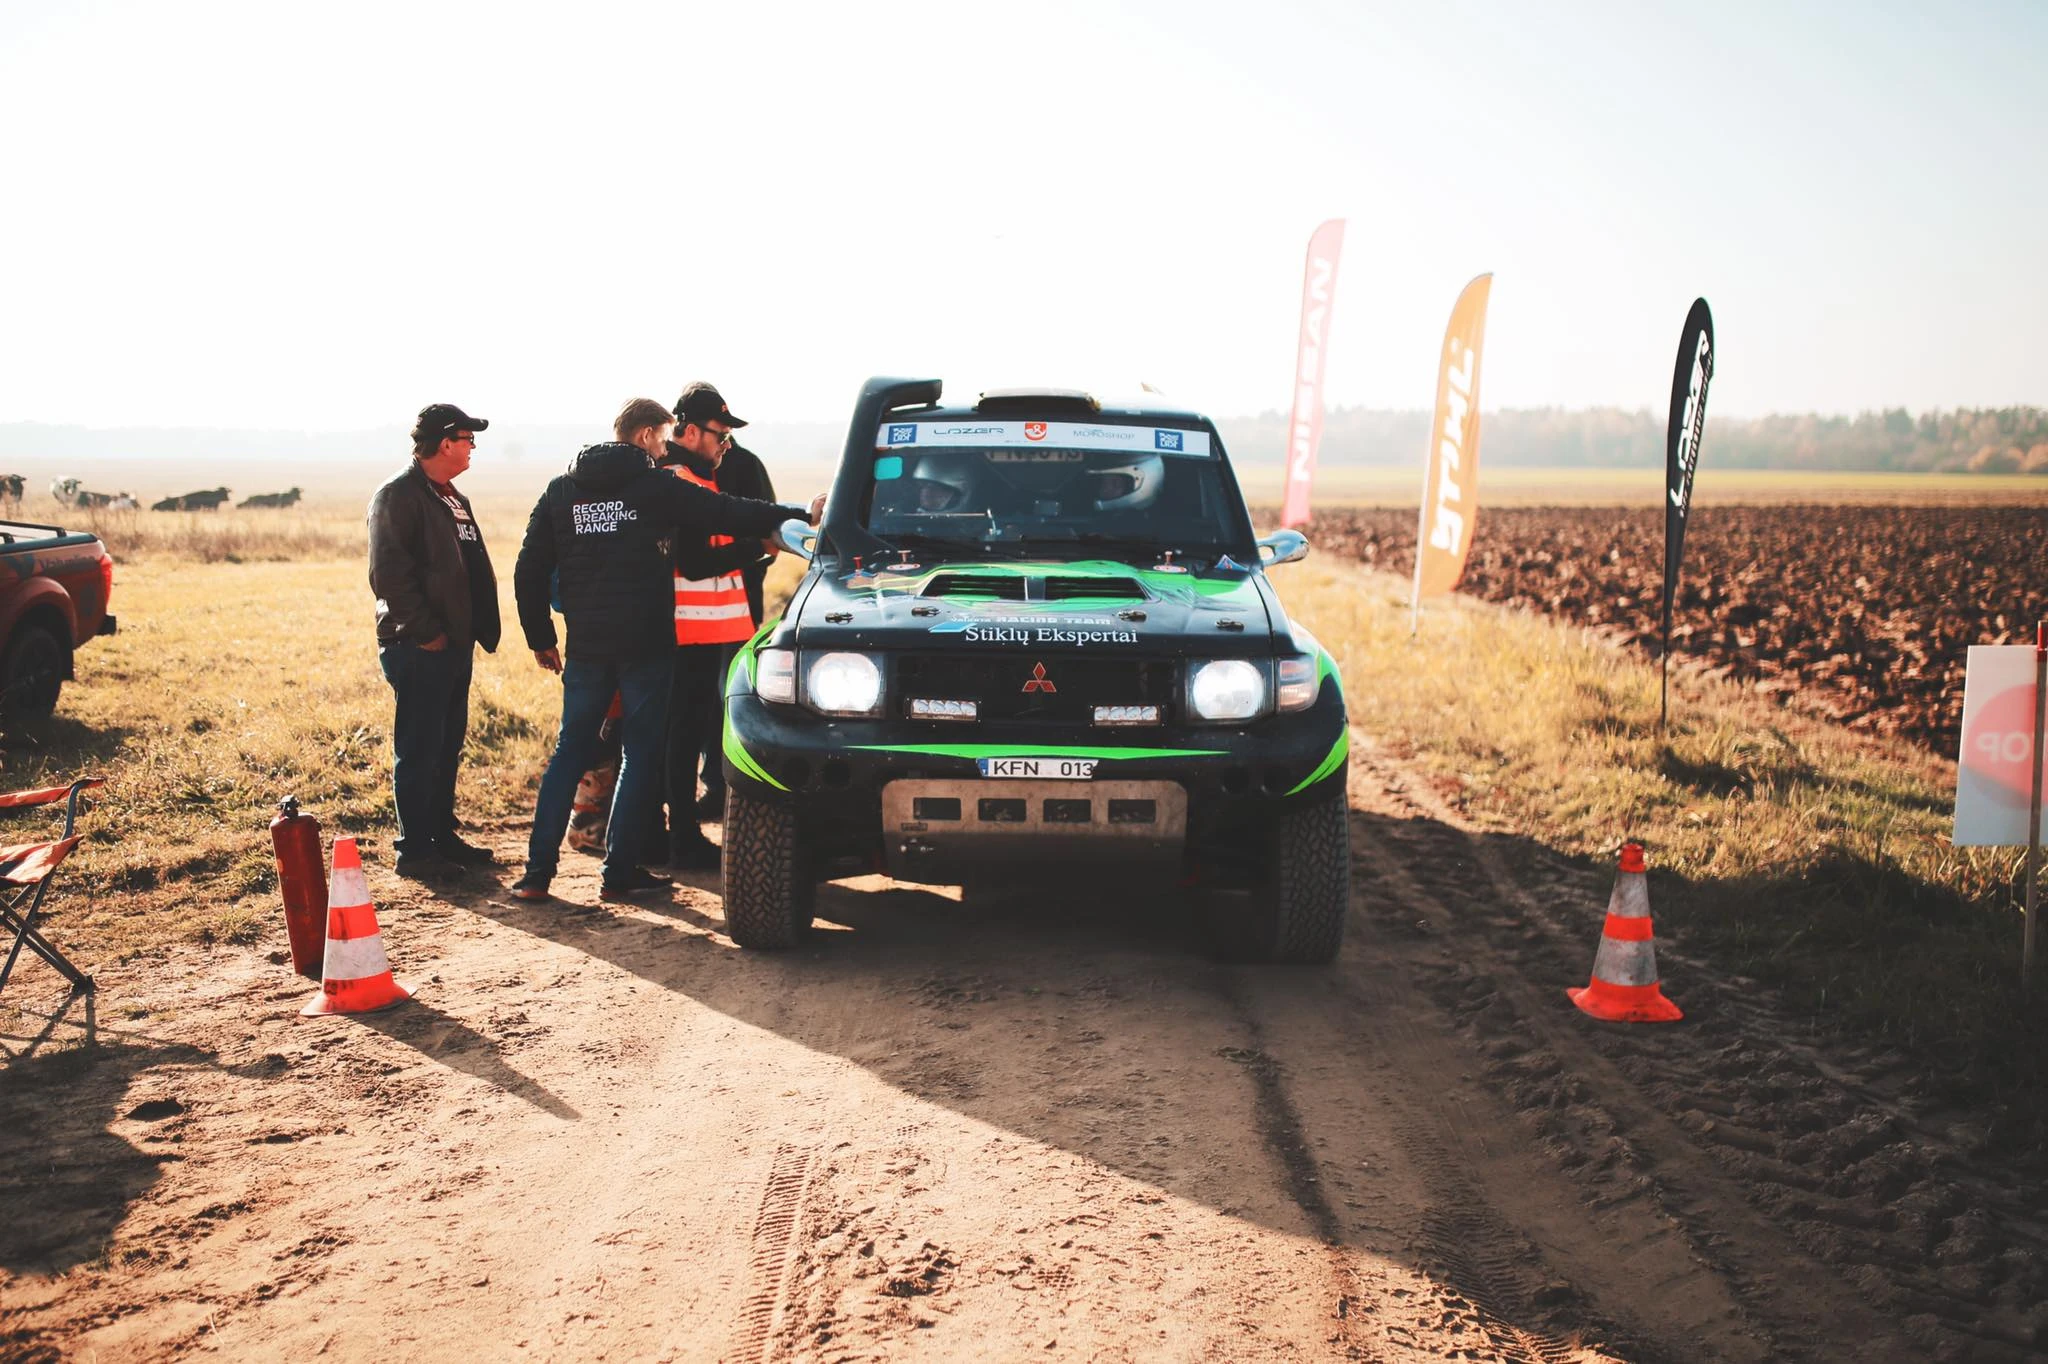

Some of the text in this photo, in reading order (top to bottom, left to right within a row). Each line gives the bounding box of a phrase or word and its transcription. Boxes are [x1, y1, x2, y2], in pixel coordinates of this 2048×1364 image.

[1292, 256, 1333, 482] NISSAN
[572, 500, 624, 515] RECORD
[574, 510, 637, 525] BREAKING
[575, 521, 618, 535] RANGE
[965, 626, 1139, 646] Stiklų Ekspertai
[994, 761, 1094, 777] KFN 013
